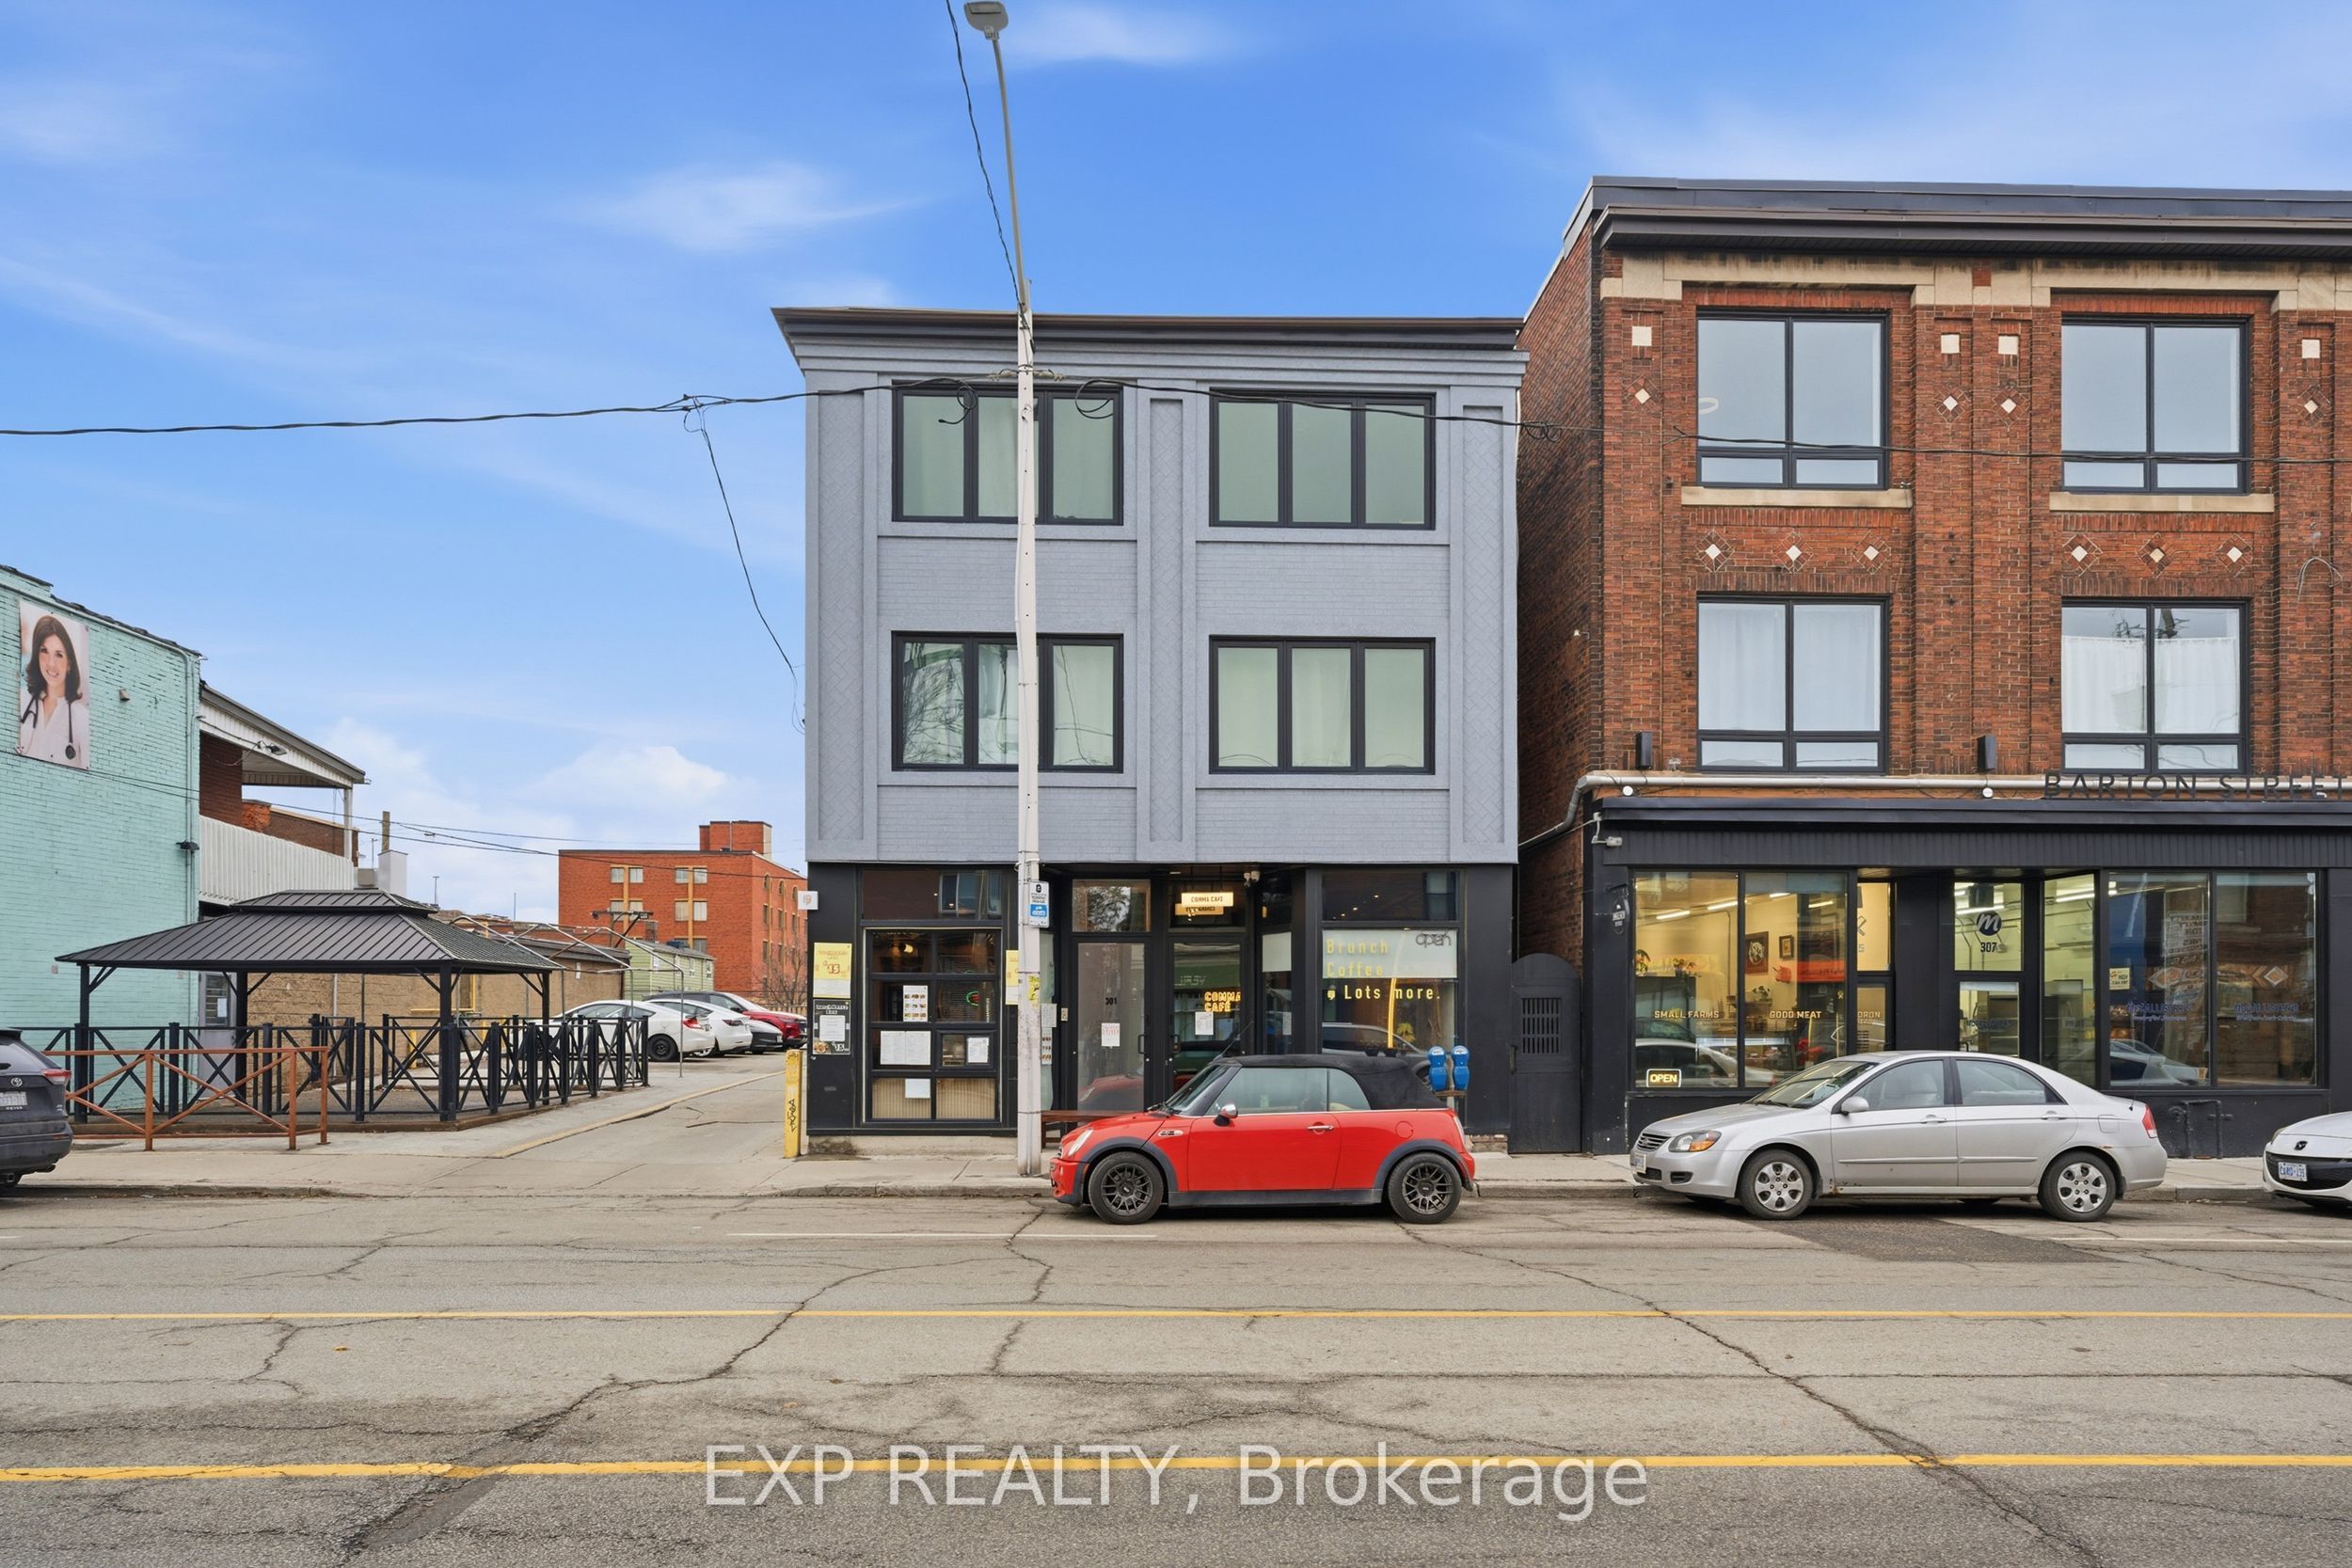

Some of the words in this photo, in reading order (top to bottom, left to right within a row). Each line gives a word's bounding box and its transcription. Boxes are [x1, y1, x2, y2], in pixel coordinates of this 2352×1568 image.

[2043, 773, 2197, 799] BARTON
[2219, 774, 2348, 799] STREET
[1327, 939, 1390, 954] Brunch
[1980, 942, 1996, 953] 307
[1327, 962, 1384, 978] Coffee
[1204, 991, 1241, 1002] COMMA
[1343, 985, 1382, 1000] Lots
[1394, 989, 1440, 1000] more.
[1654, 1010, 1686, 1019] SMALL
[1688, 1010, 1720, 1019] FARMS
[1770, 1010, 1794, 1019] GOOD
[1797, 1010, 1822, 1019] MEAT
[1649, 1073, 1677, 1084] OPEN
